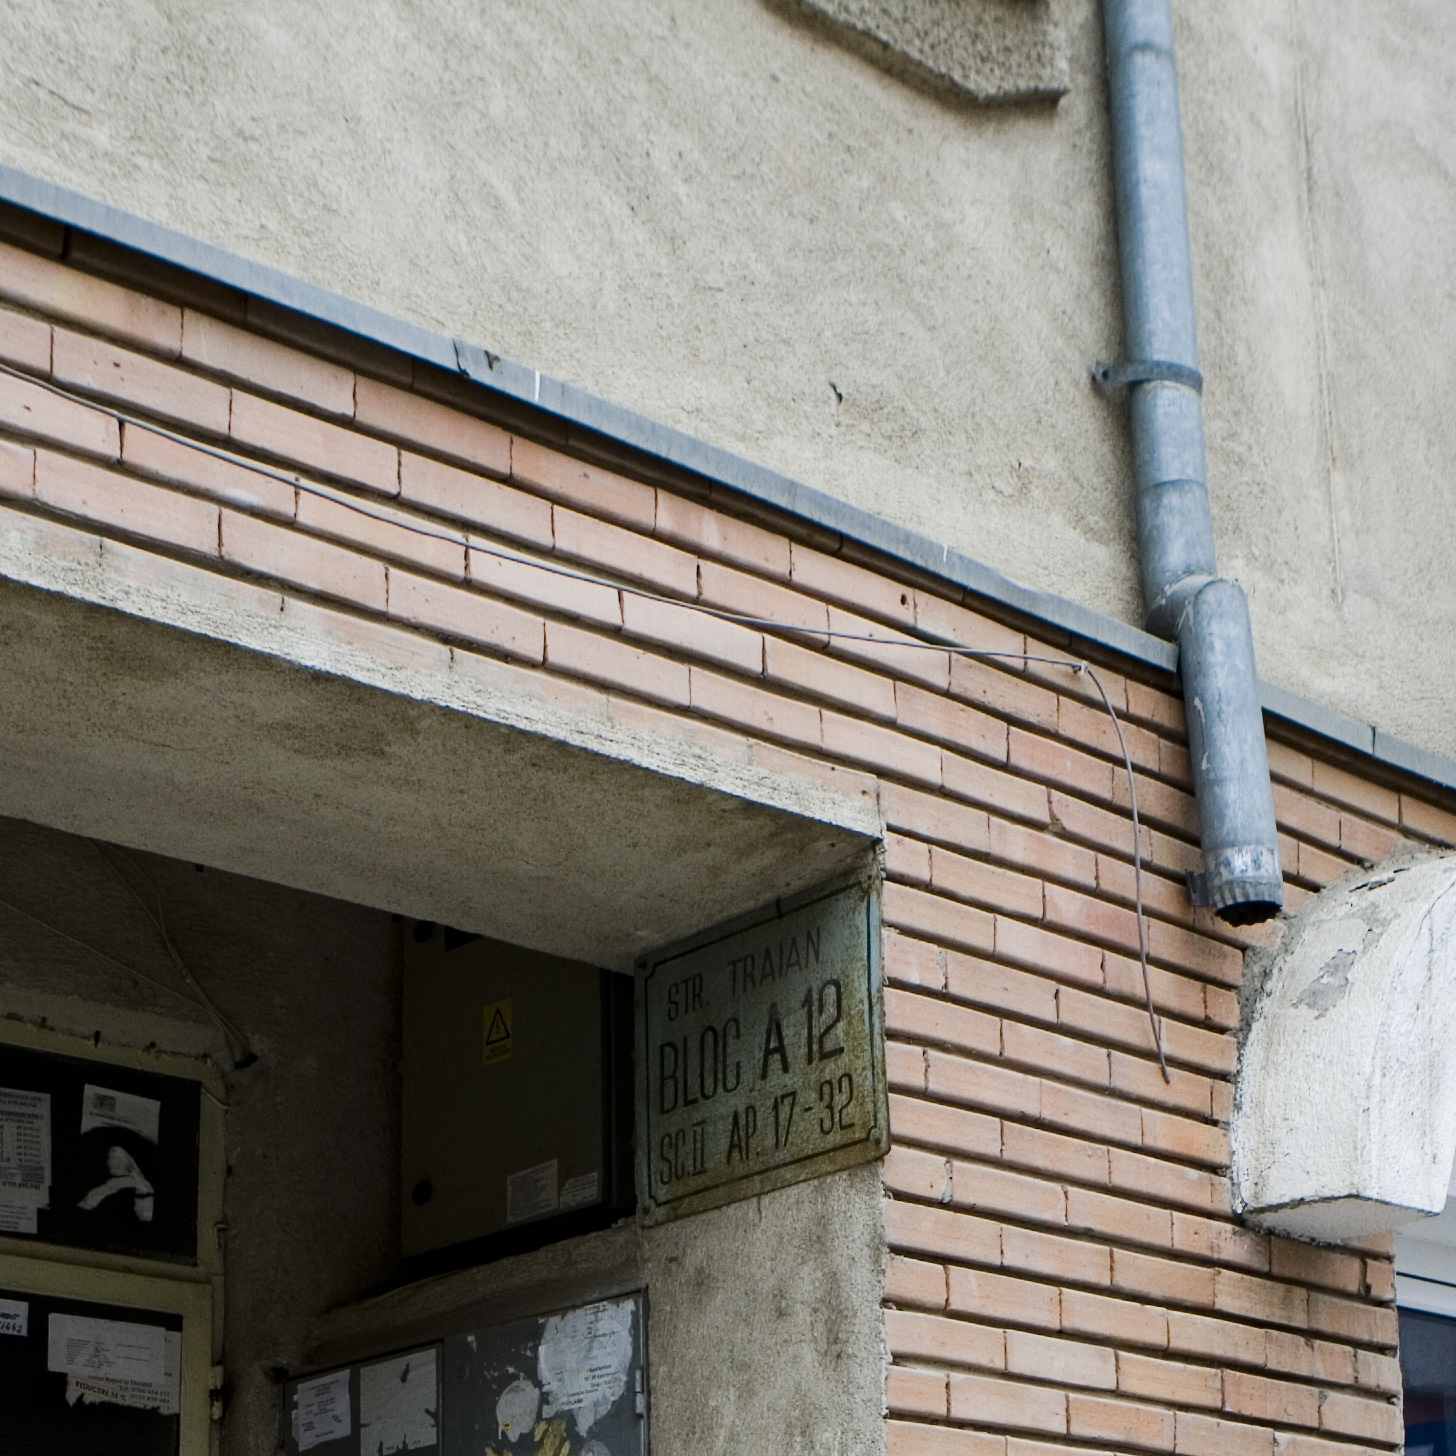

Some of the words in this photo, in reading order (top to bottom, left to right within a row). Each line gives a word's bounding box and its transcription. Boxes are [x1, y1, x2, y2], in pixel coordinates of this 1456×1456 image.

[666, 972, 710, 1022] STR.
[726, 926, 821, 998] TRAIAN
[658, 1016, 742, 1116] BLOC
[760, 1001, 790, 1081] A
[801, 978, 846, 1066] 12
[726, 1105, 761, 1166] AP.
